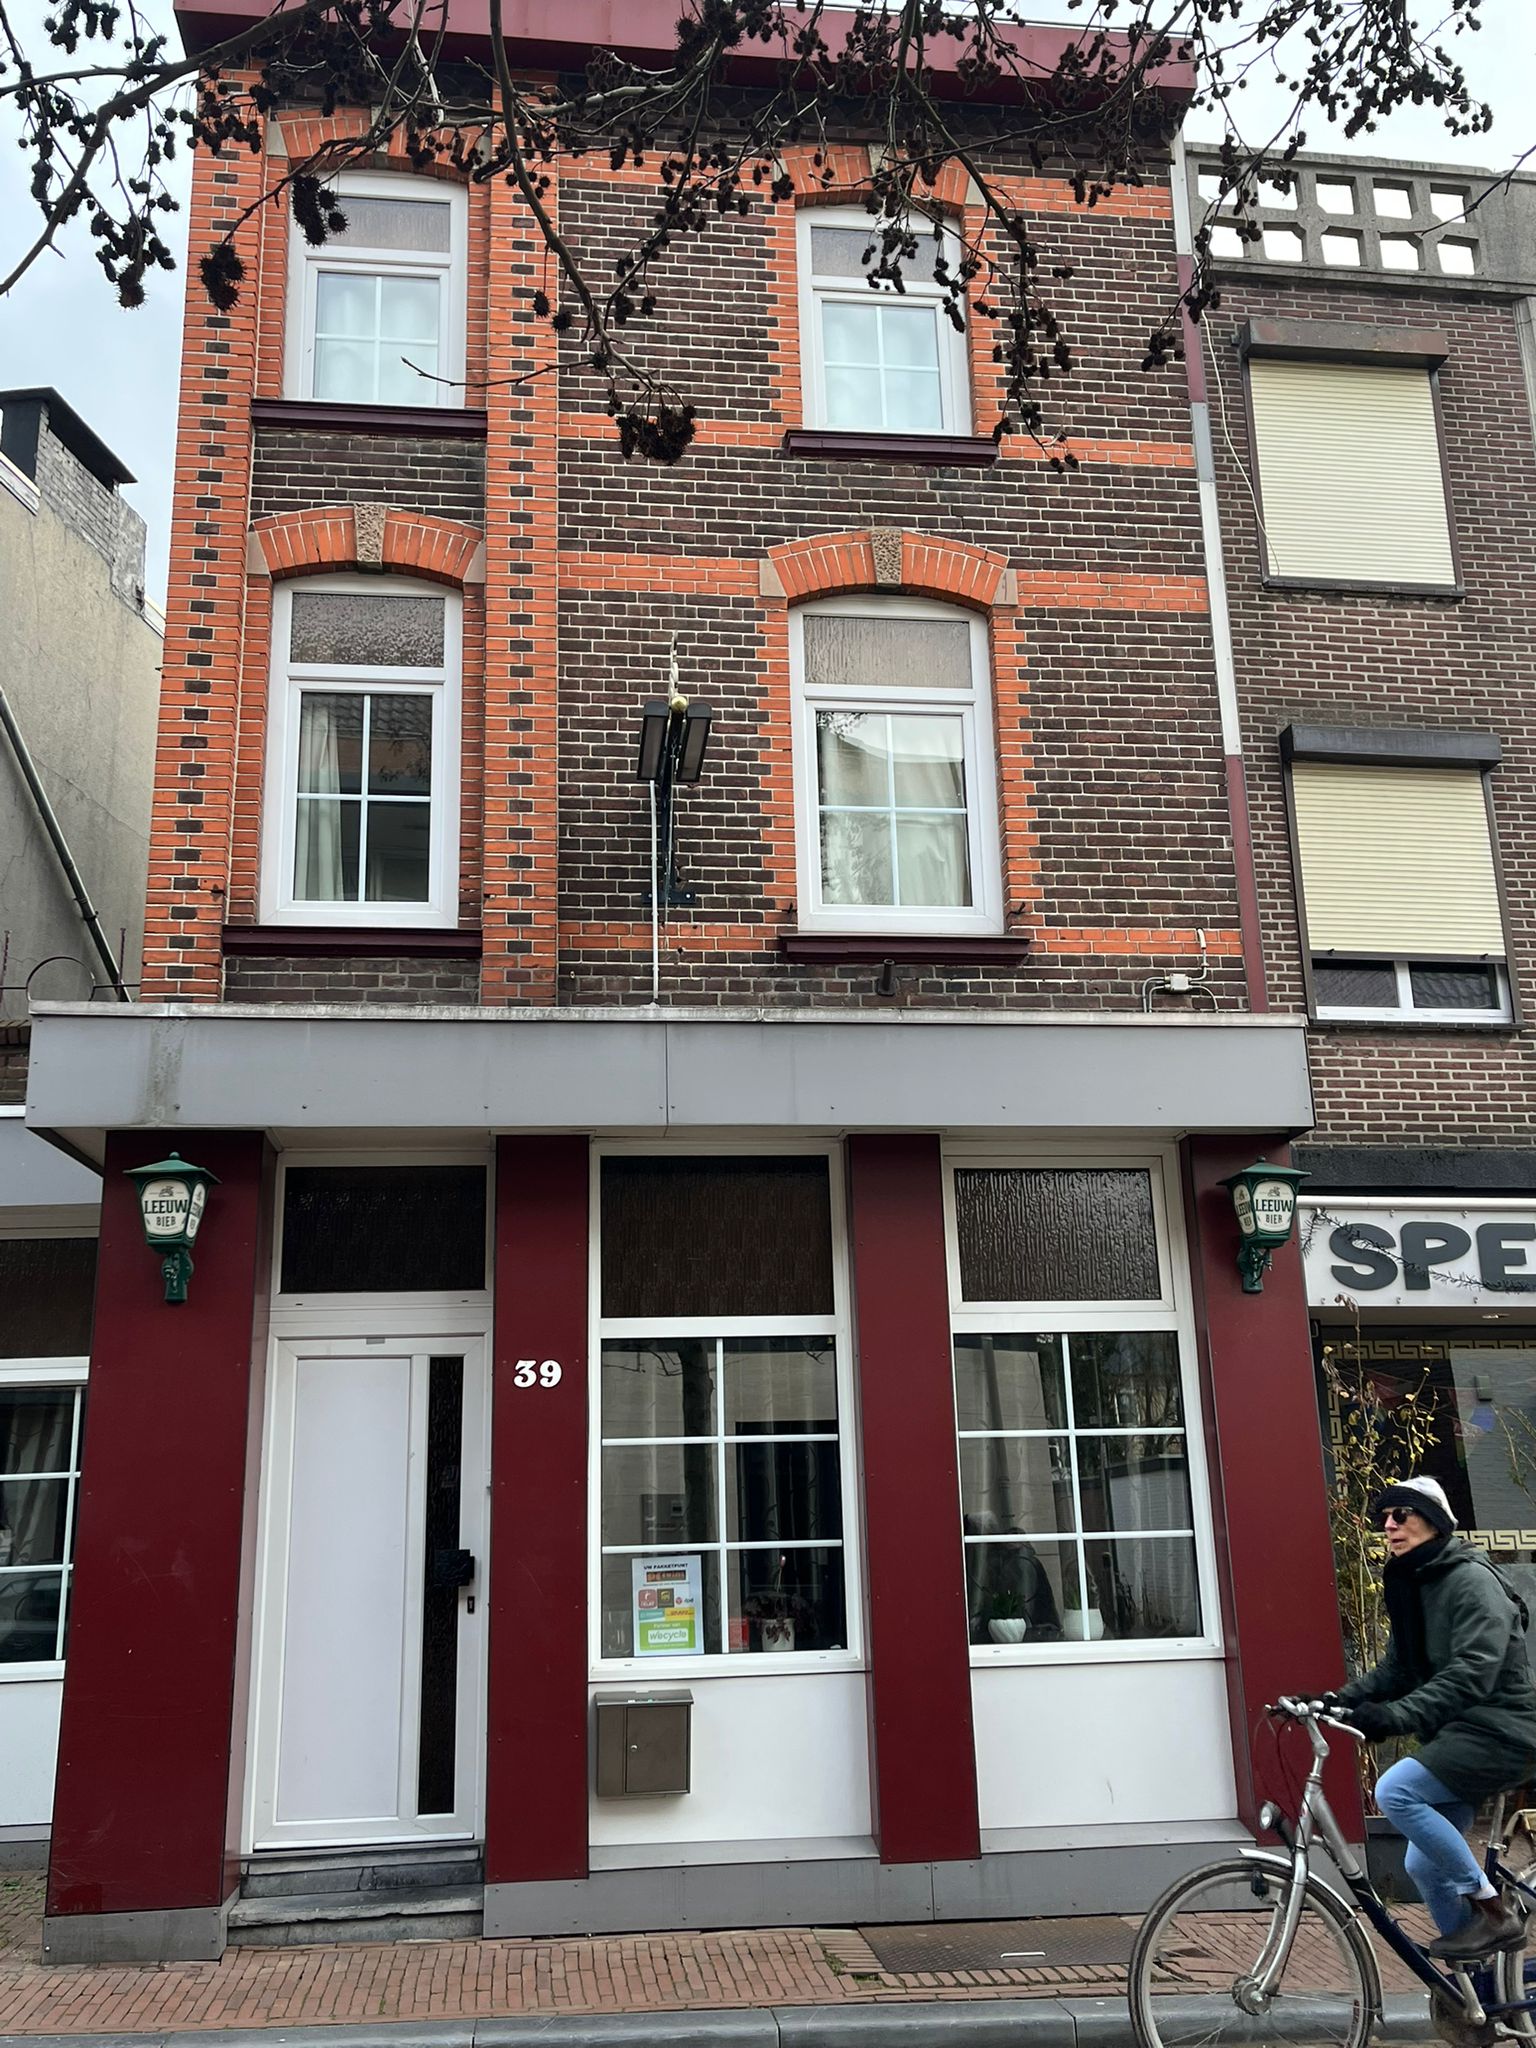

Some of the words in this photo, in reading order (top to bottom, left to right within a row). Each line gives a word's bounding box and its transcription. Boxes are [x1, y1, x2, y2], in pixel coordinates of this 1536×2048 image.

[144, 1200, 187, 1214] LEEUW
[1255, 1199, 1292, 1212] LEEUW
[156, 1216, 176, 1227] BIER
[1265, 1214, 1283, 1224] BIER
[1329, 1221, 1536, 1292] SPE
[513, 1359, 562, 1388] 39
